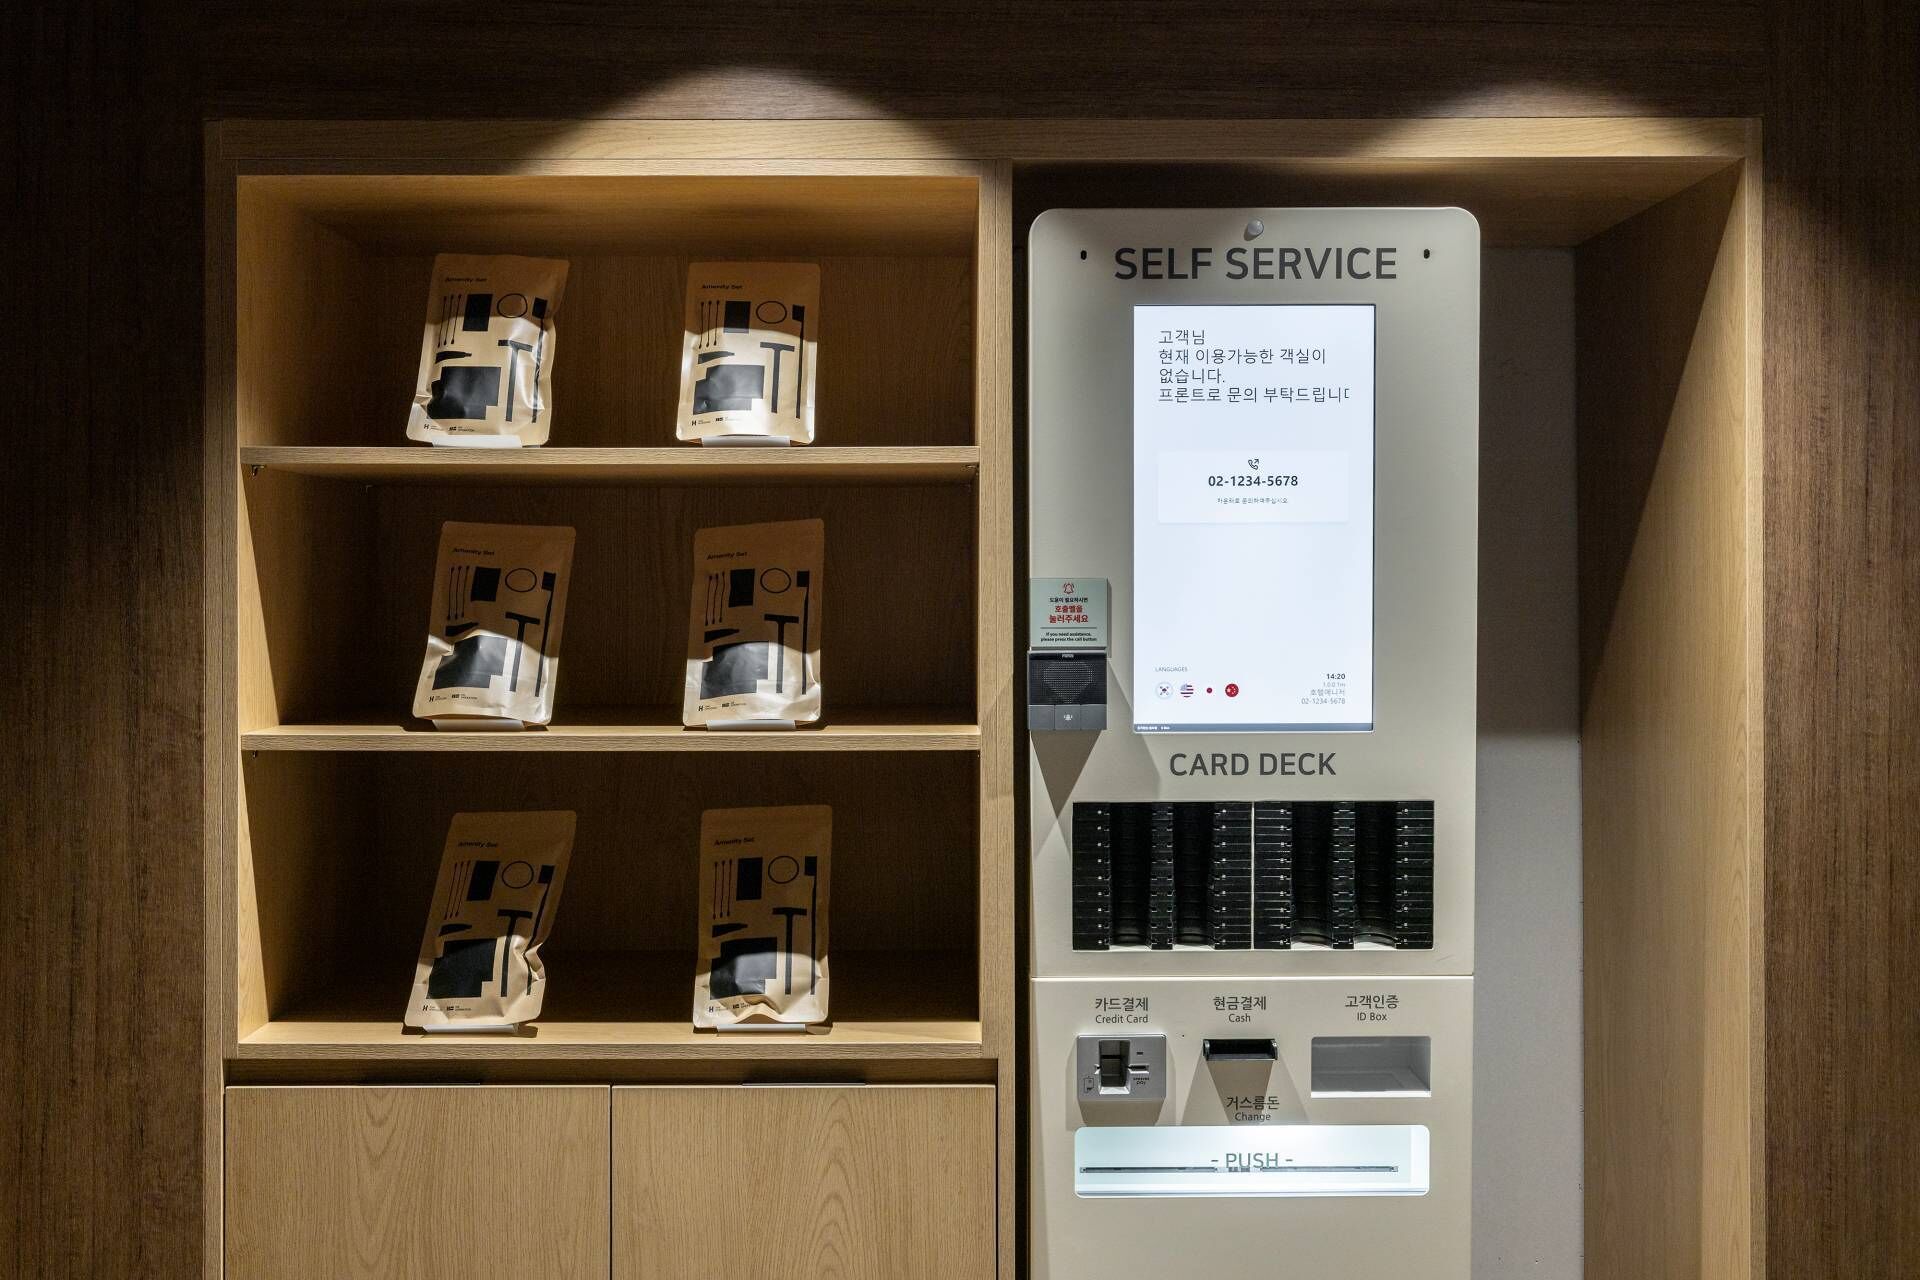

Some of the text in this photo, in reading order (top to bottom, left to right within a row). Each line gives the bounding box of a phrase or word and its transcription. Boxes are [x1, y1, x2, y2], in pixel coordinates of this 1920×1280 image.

[1114, 247, 1397, 280] SELF SERVICE
[1158, 329, 1205, 345] 고객님
[1159, 348, 1326, 365] 현재 이용가능한 객실이
[1159, 368, 1226, 384] 없습니다.
[1158, 387, 1222, 403] 프론트로
[1227, 387, 1257, 403] 문의
[1207, 475, 1298, 487] 02-1234-5678
[1055, 605, 1083, 613] 호출벨을
[1049, 614, 1089, 624] 눌러주세요
[1169, 752, 1337, 776] CARD DECK
[1095, 997, 1149, 1012] 카드결제
[1213, 996, 1267, 1011] 현금결제
[1345, 994, 1400, 1009] 고객인증
[1095, 1014, 1149, 1024] Credit Card
[1228, 1013, 1251, 1023] Cash
[1357, 1012, 1388, 1021] ID Box
[1226, 1095, 1280, 1111] 거스름돈
[1234, 1111, 1271, 1122] Change
[1225, 1152, 1279, 1169] PUSH
